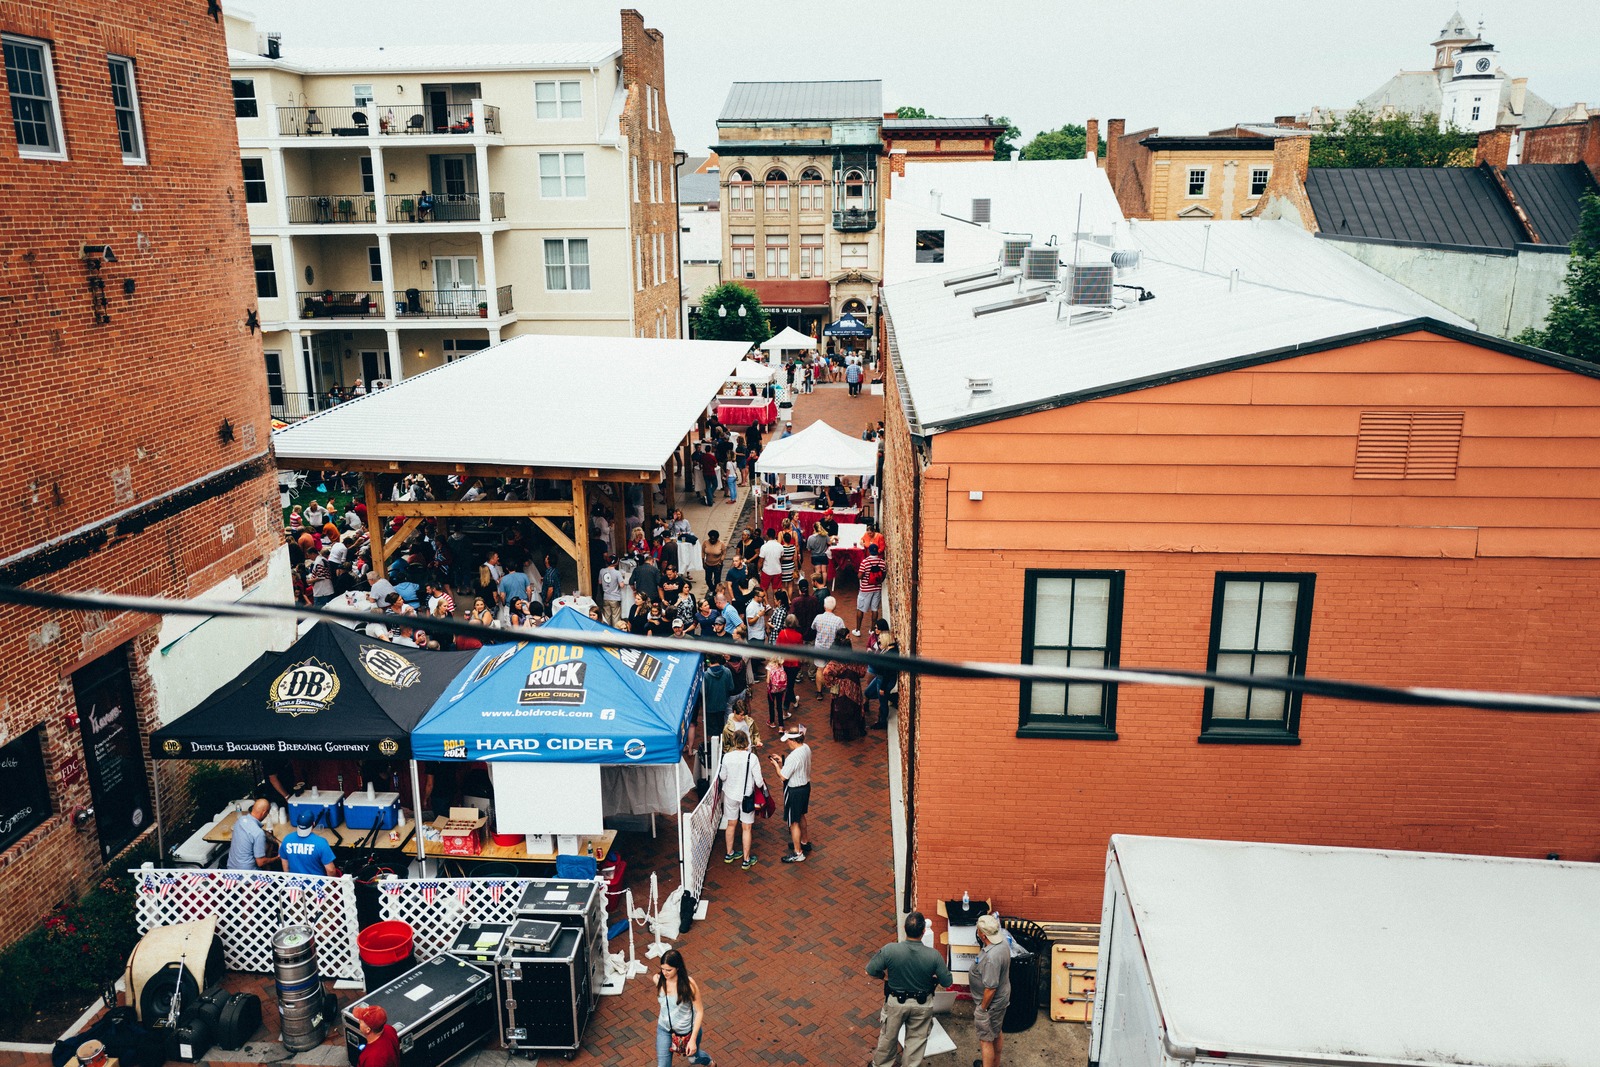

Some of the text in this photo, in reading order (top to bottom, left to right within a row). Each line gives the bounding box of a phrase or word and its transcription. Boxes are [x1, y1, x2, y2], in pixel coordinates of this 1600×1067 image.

[368, 651, 402, 677] DB
[531, 645, 584, 672] BOLD
[528, 662, 583, 686] ROCK
[286, 671, 326, 697] DB
[481, 709, 593, 718] www.boldrock.com
[167, 741, 178, 750] DB
[383, 741, 394, 750] DB
[443, 739, 465, 751] BOLD
[476, 739, 540, 750] HARD
[546, 738, 613, 750] CIDER
[444, 747, 467, 758] ROCK
[61, 760, 79, 778] FDC
[286, 842, 315, 855] STAFF
